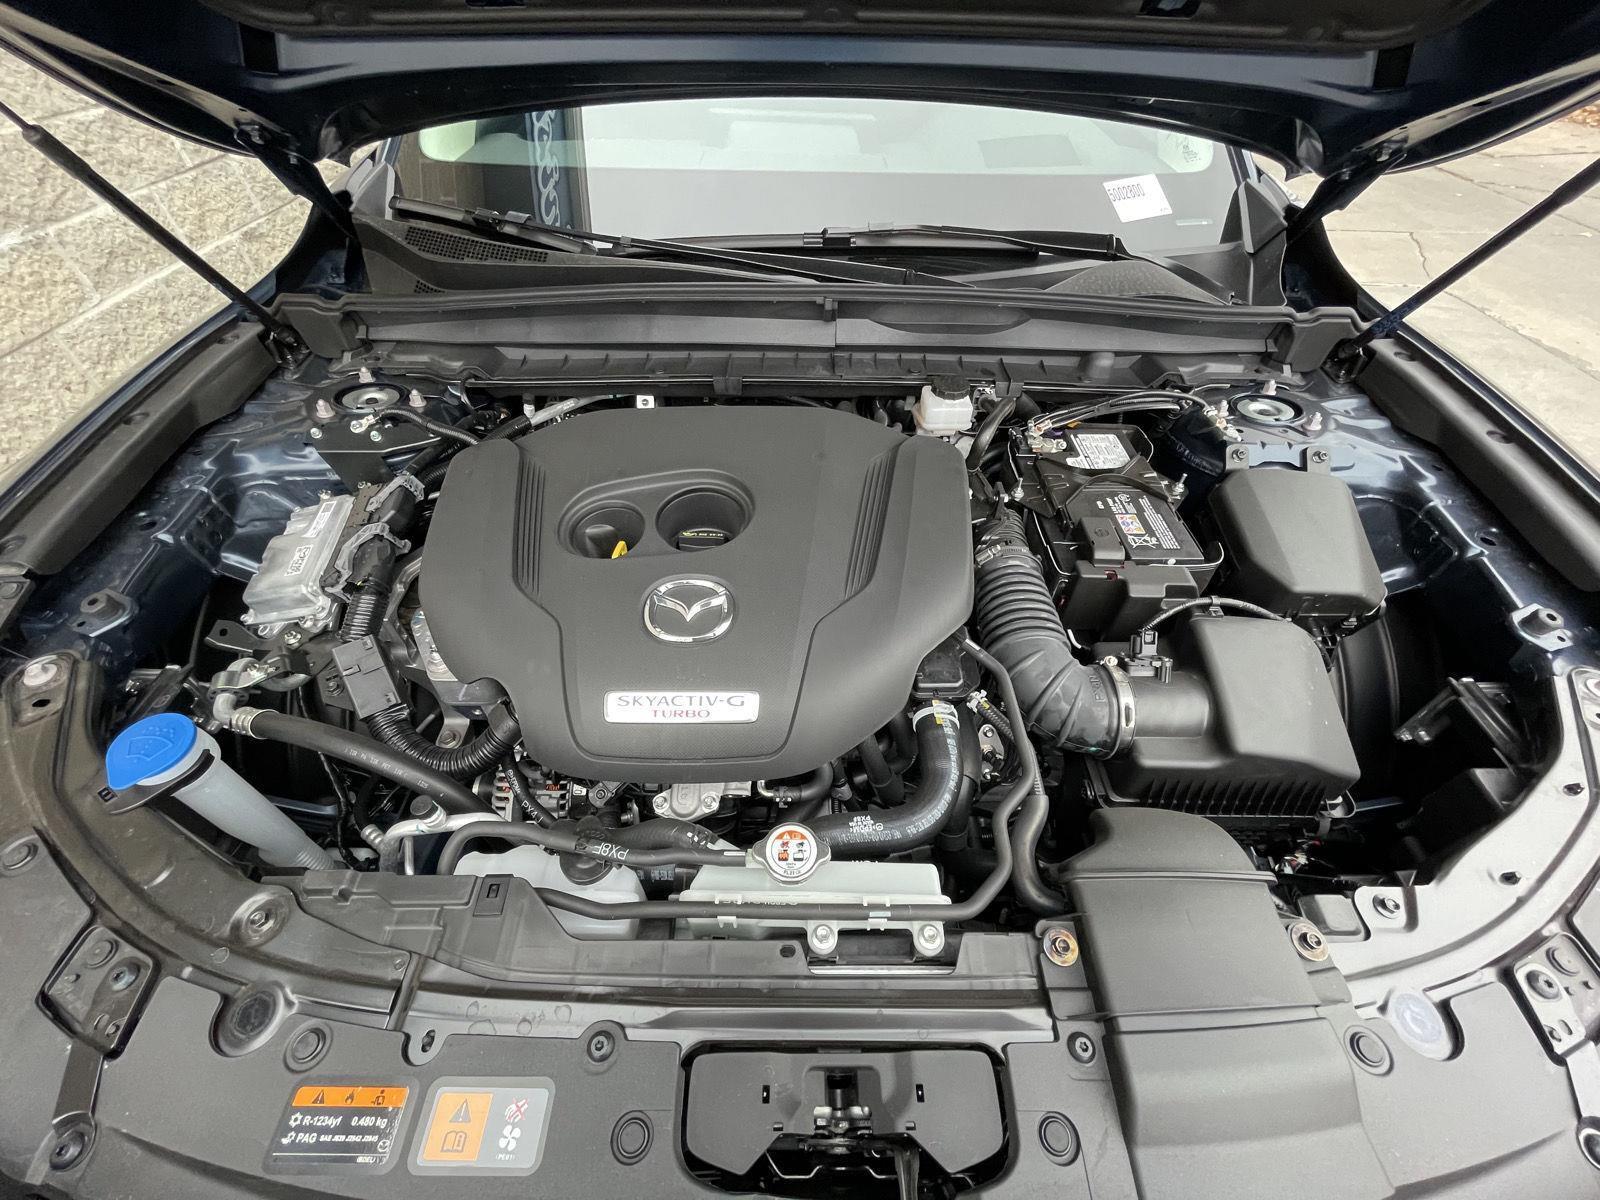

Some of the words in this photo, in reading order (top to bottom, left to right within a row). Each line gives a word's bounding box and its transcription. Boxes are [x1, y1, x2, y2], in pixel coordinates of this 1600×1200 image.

[616, 695, 745, 707] SKYACTIV-G
[651, 709, 711, 718] TURBO
[351, 1116, 375, 1127] 0.480
[376, 1117, 388, 1128] kg
[296, 1132, 317, 1144] PAG
